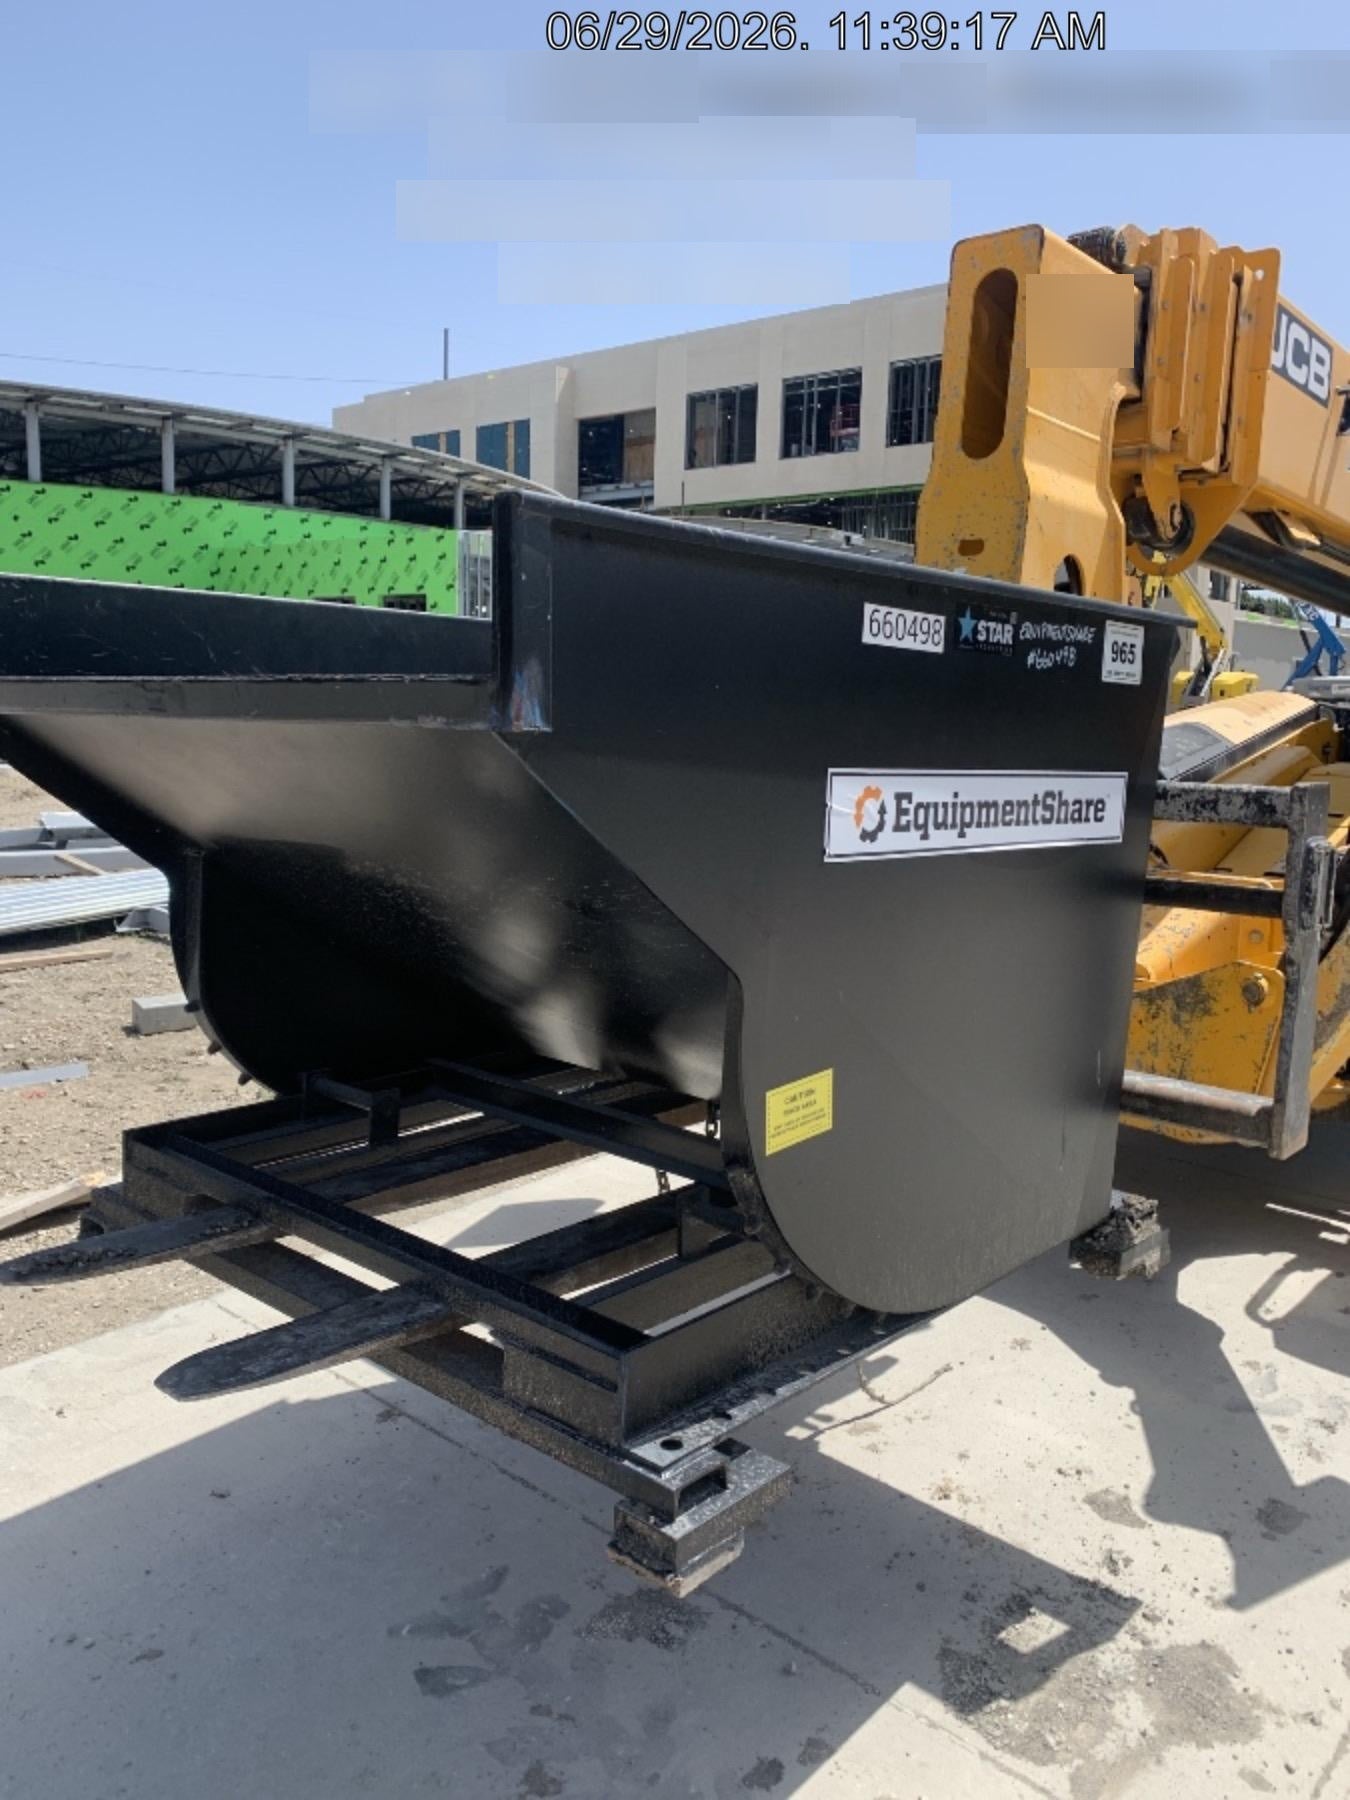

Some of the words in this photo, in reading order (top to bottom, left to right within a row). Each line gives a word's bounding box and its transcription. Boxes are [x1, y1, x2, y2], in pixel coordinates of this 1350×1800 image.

[1271, 312, 1331, 400] JCB
[869, 608, 942, 647] 660498
[977, 619, 1013, 645] STAR
[1111, 638, 1136, 665] 965
[892, 790, 1106, 840] EquipmentShare
